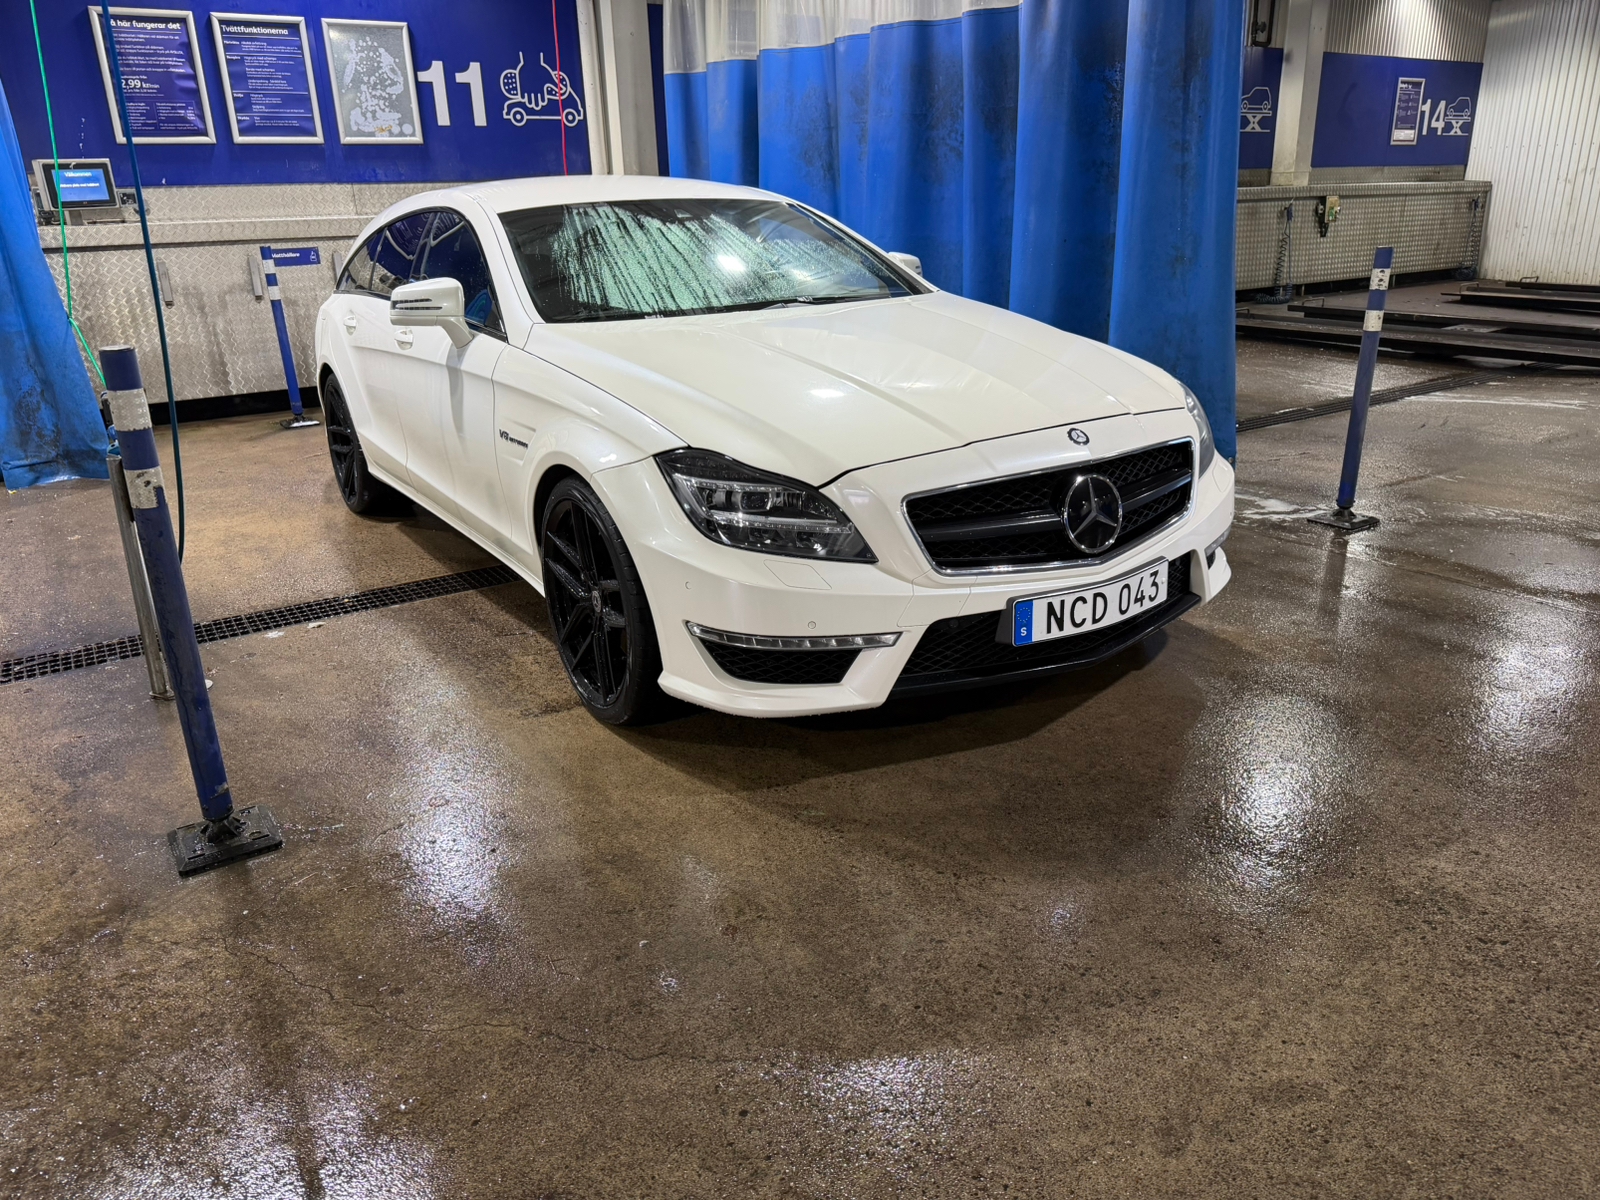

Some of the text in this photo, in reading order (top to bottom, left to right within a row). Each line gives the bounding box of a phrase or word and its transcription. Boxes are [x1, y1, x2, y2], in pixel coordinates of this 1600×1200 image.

[132, 20, 166, 30] fungerar
[167, 21, 181, 30] det
[221, 25, 289, 35] Tvättfunktionerna
[121, 79, 141, 89] 2,99
[417, 60, 487, 127] 11
[1421, 99, 1446, 136] 14
[1046, 568, 1160, 635] NCD 043
[1020, 627, 1027, 636] S
